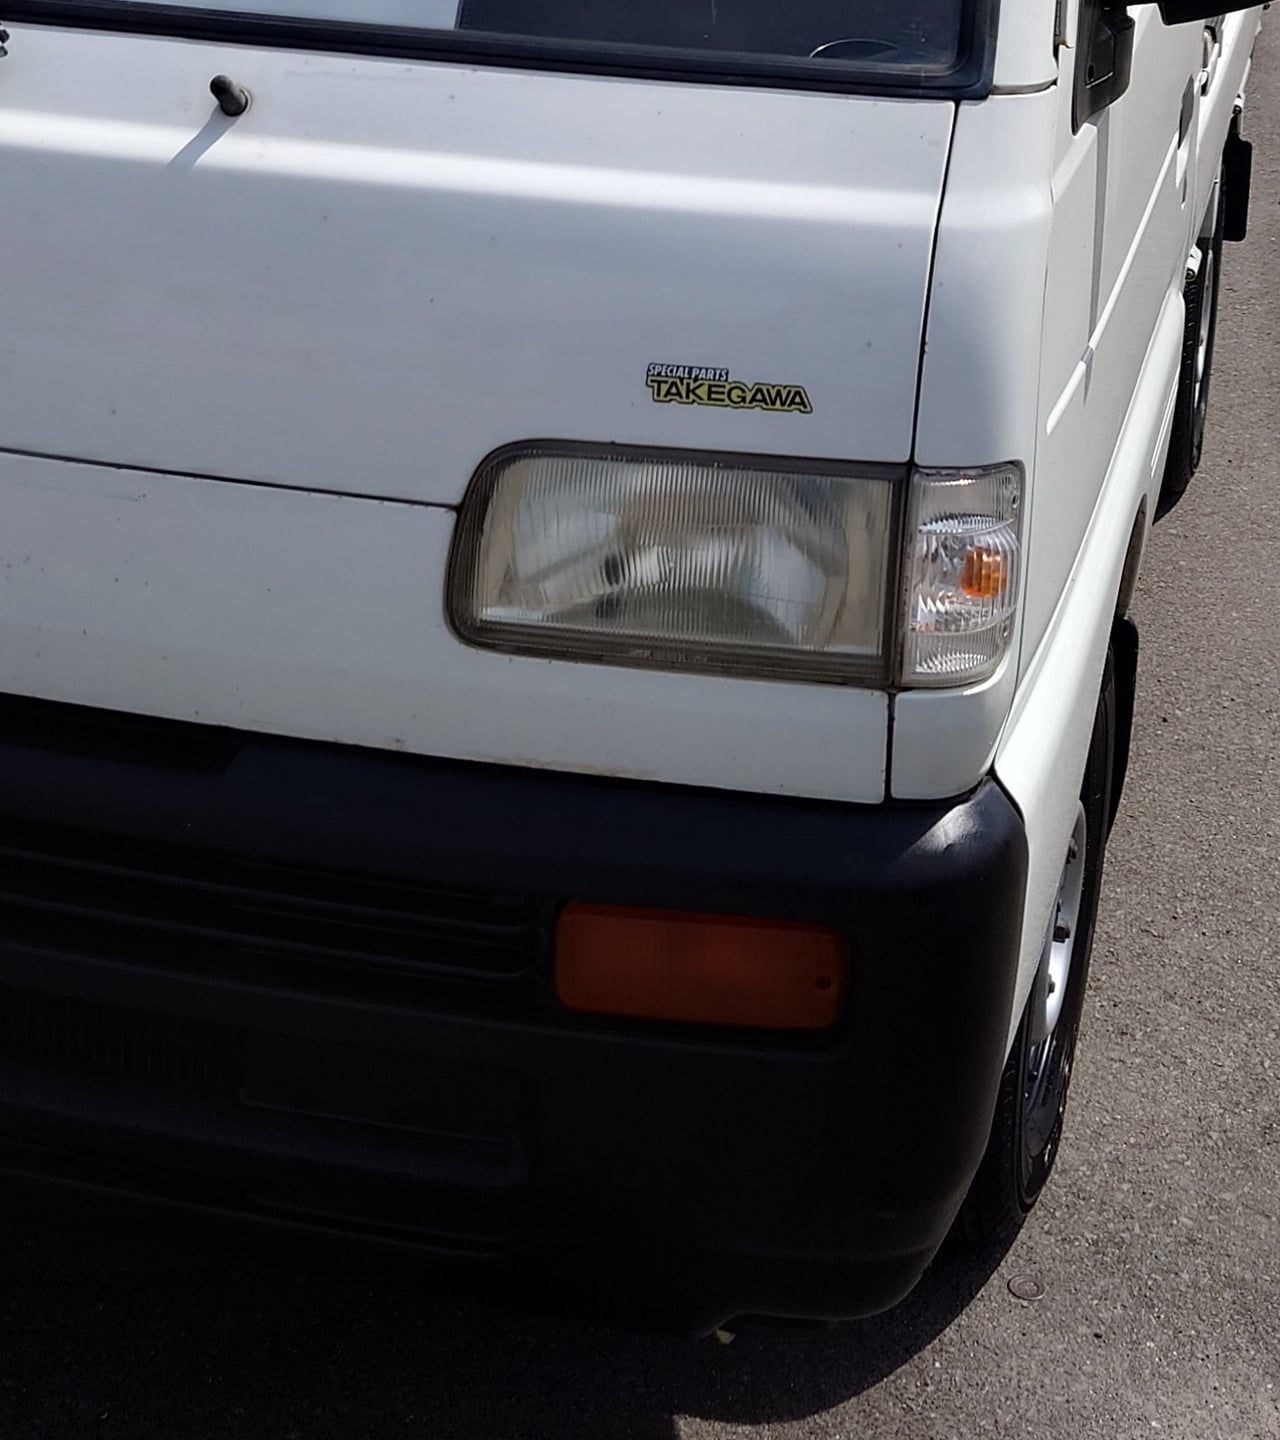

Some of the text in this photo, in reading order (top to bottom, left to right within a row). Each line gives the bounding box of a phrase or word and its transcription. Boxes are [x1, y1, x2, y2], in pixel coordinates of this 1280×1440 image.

[648, 363, 728, 381] SPECIAL PARTS
[648, 377, 810, 411] TAKEGAWA
